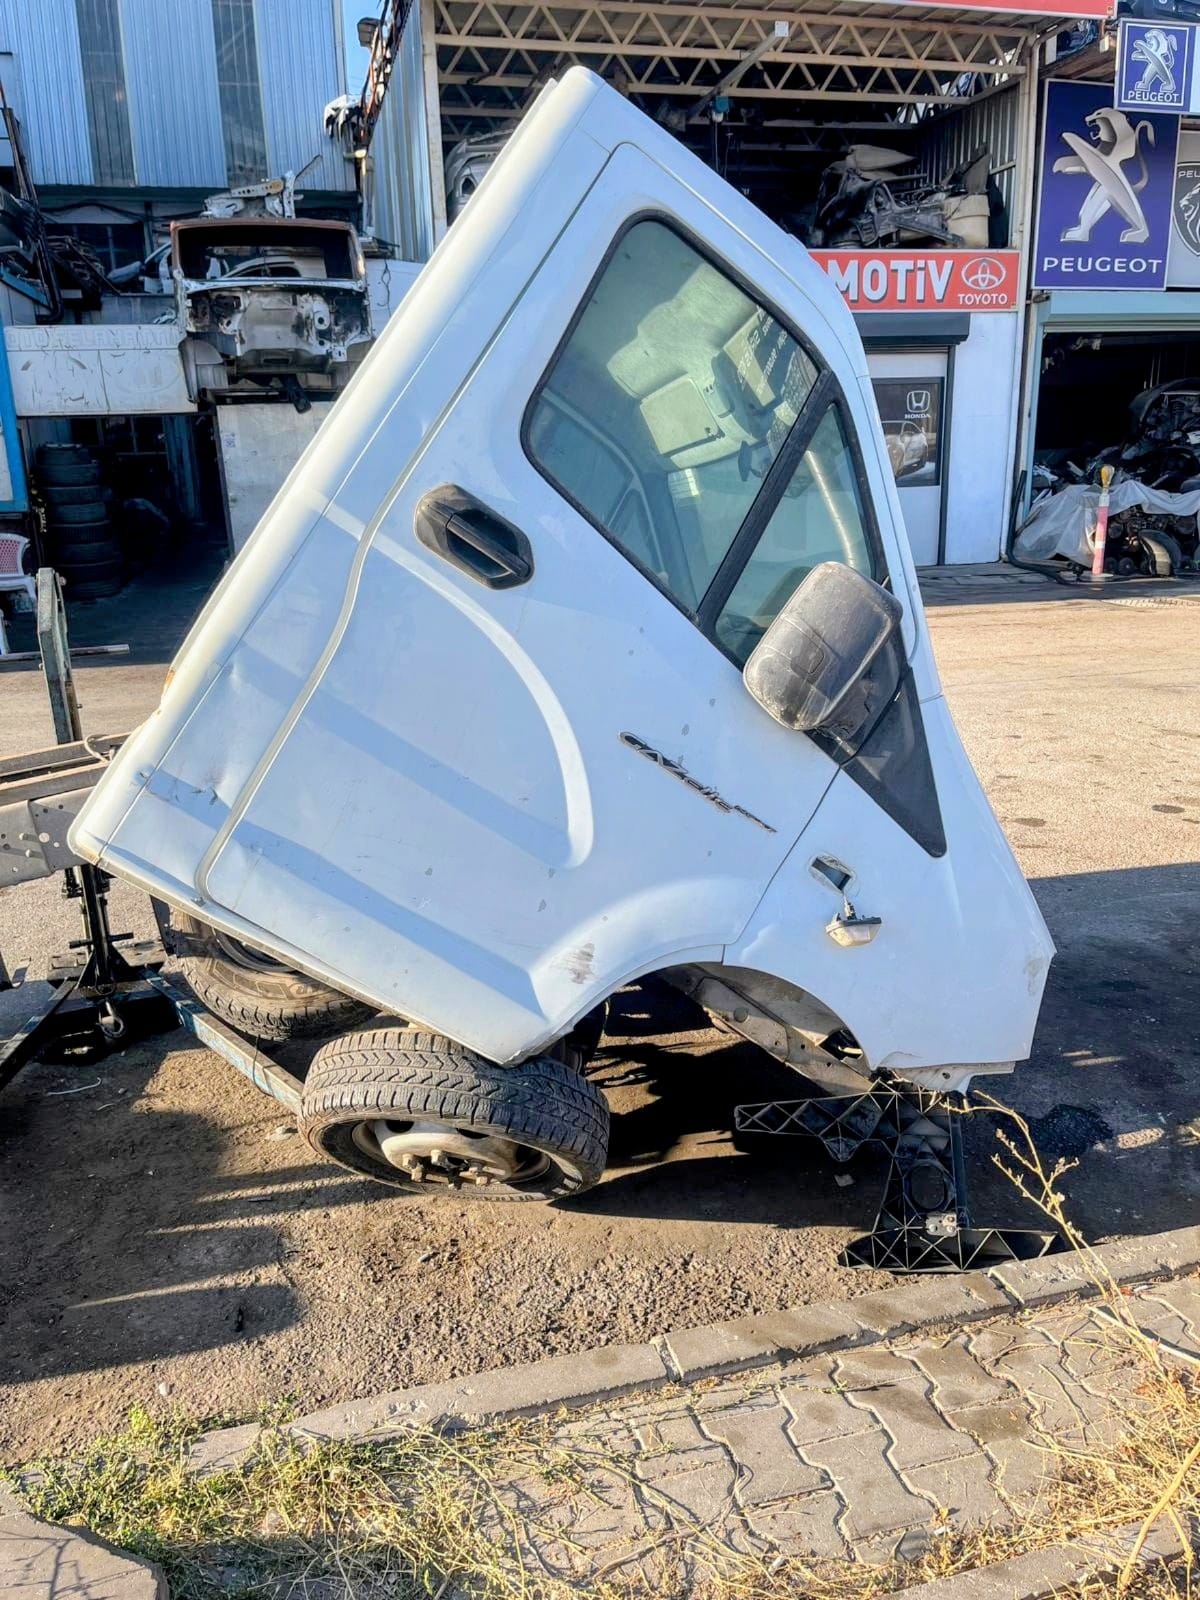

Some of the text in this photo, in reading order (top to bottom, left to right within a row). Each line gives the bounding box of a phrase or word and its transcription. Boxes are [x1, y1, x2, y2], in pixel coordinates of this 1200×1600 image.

[1128, 90, 1179, 102] PEUGEOT
[1043, 257, 1162, 273] PEUGEOT
[958, 293, 1008, 305] TOYOTO
